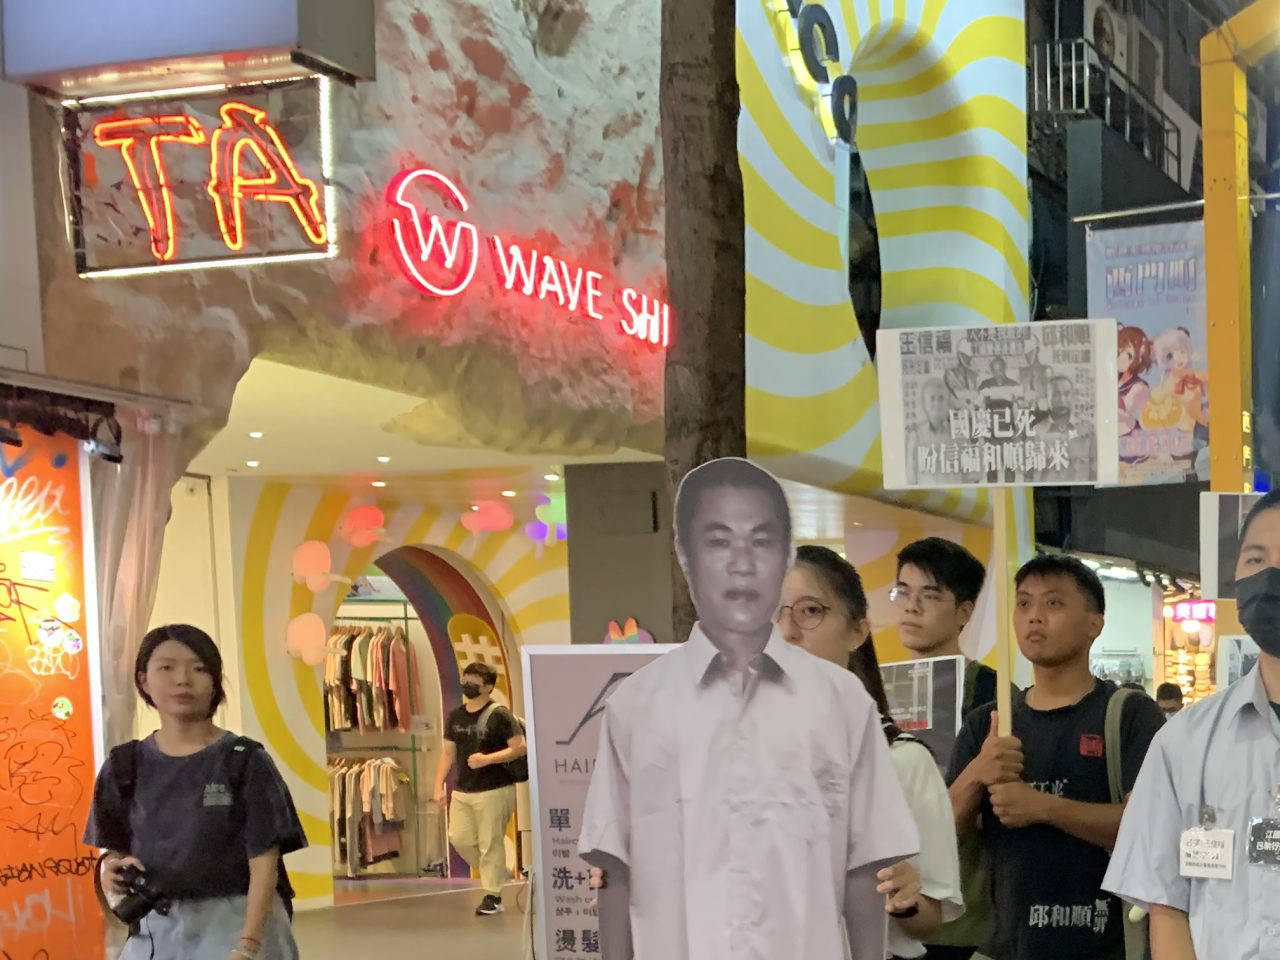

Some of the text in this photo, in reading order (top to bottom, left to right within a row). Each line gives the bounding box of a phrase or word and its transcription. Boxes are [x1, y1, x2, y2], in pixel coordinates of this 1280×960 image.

[94, 102, 328, 261] TA
[493, 234, 669, 347] WAVE SHI
[949, 407, 1036, 440] 國慶已死
[918, 441, 1068, 474] 盼信福和順歸來
[556, 758, 595, 774] HAI
[552, 866, 598, 890] 洗+
